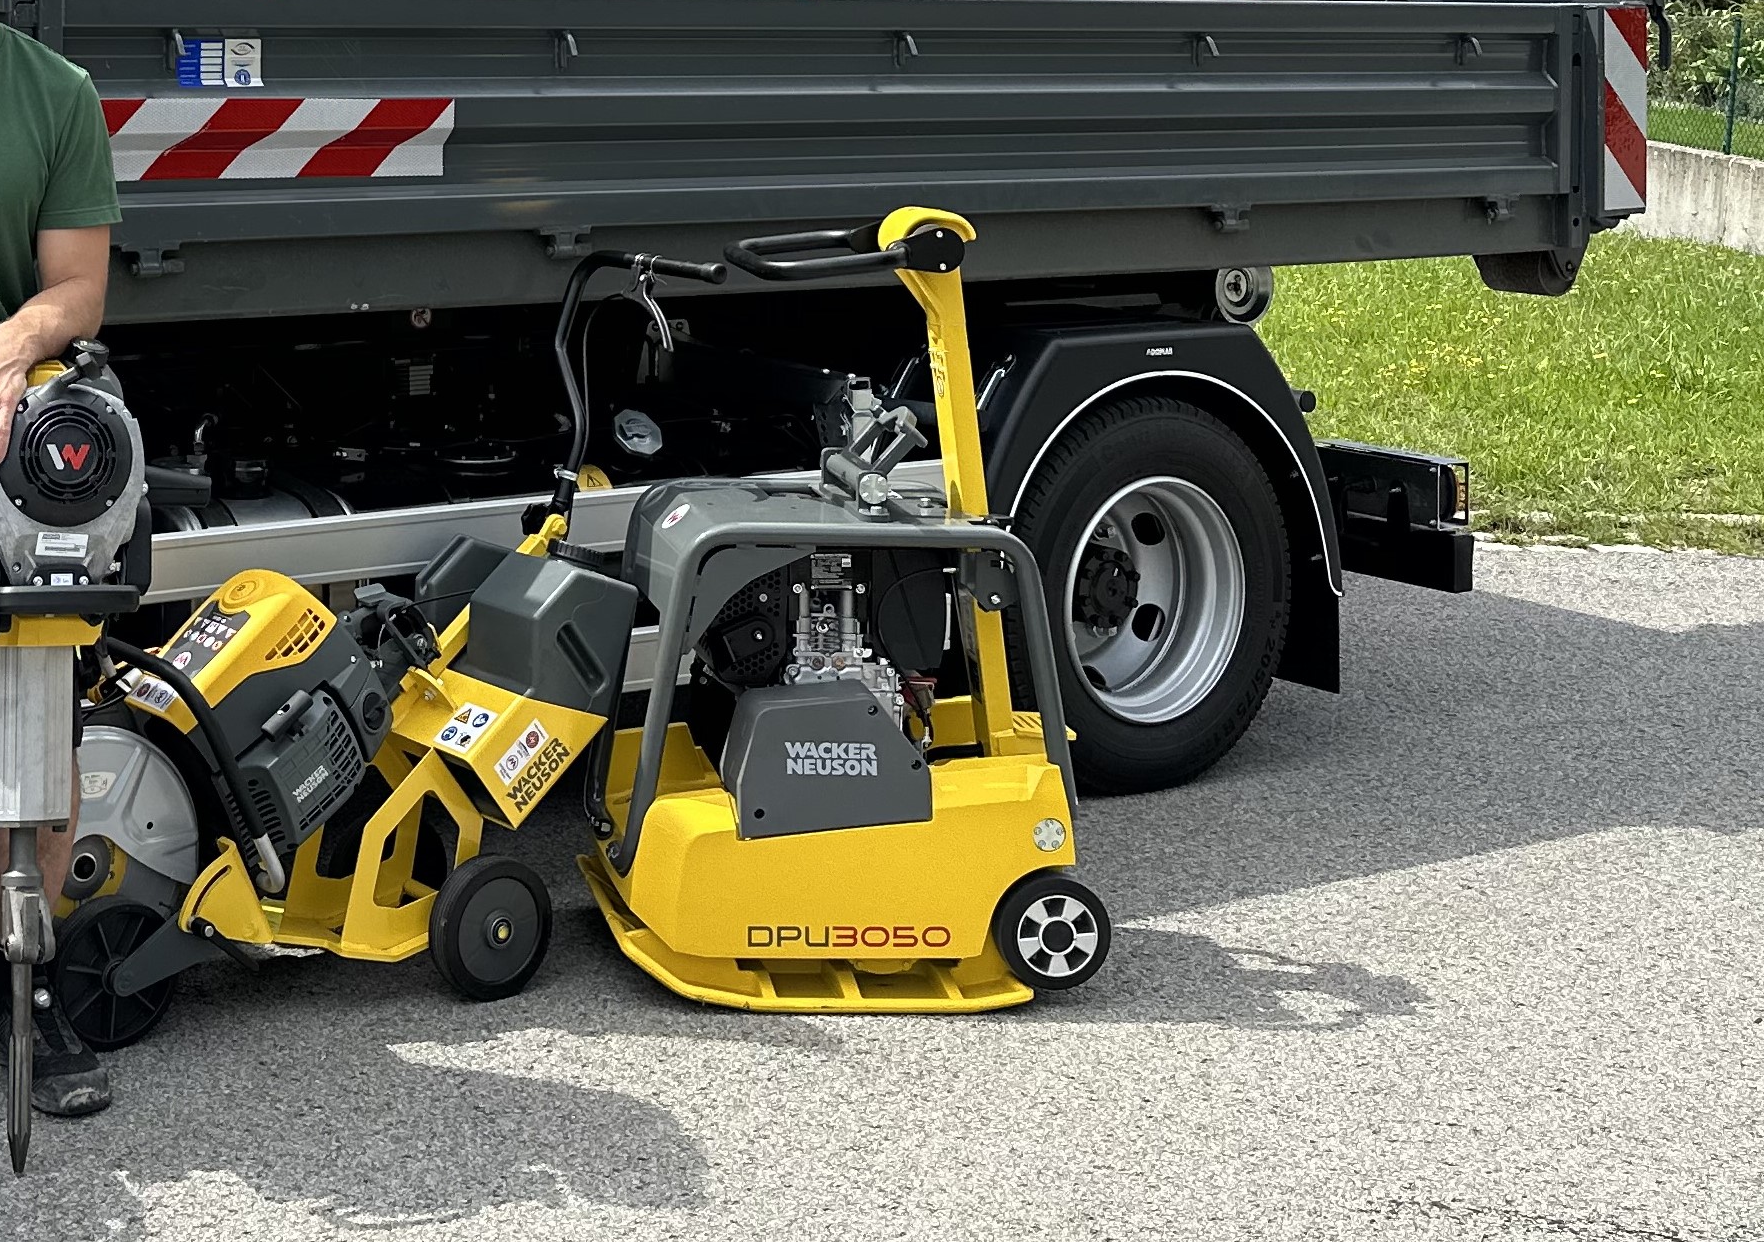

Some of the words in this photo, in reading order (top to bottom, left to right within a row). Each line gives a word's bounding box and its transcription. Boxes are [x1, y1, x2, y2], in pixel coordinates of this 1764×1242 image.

[784, 741, 878, 760] WACKER
[506, 737, 563, 801] WACKER
[514, 745, 571, 813] NEUSON
[786, 758, 878, 777] NEUSON
[747, 925, 952, 948] DPU3050
